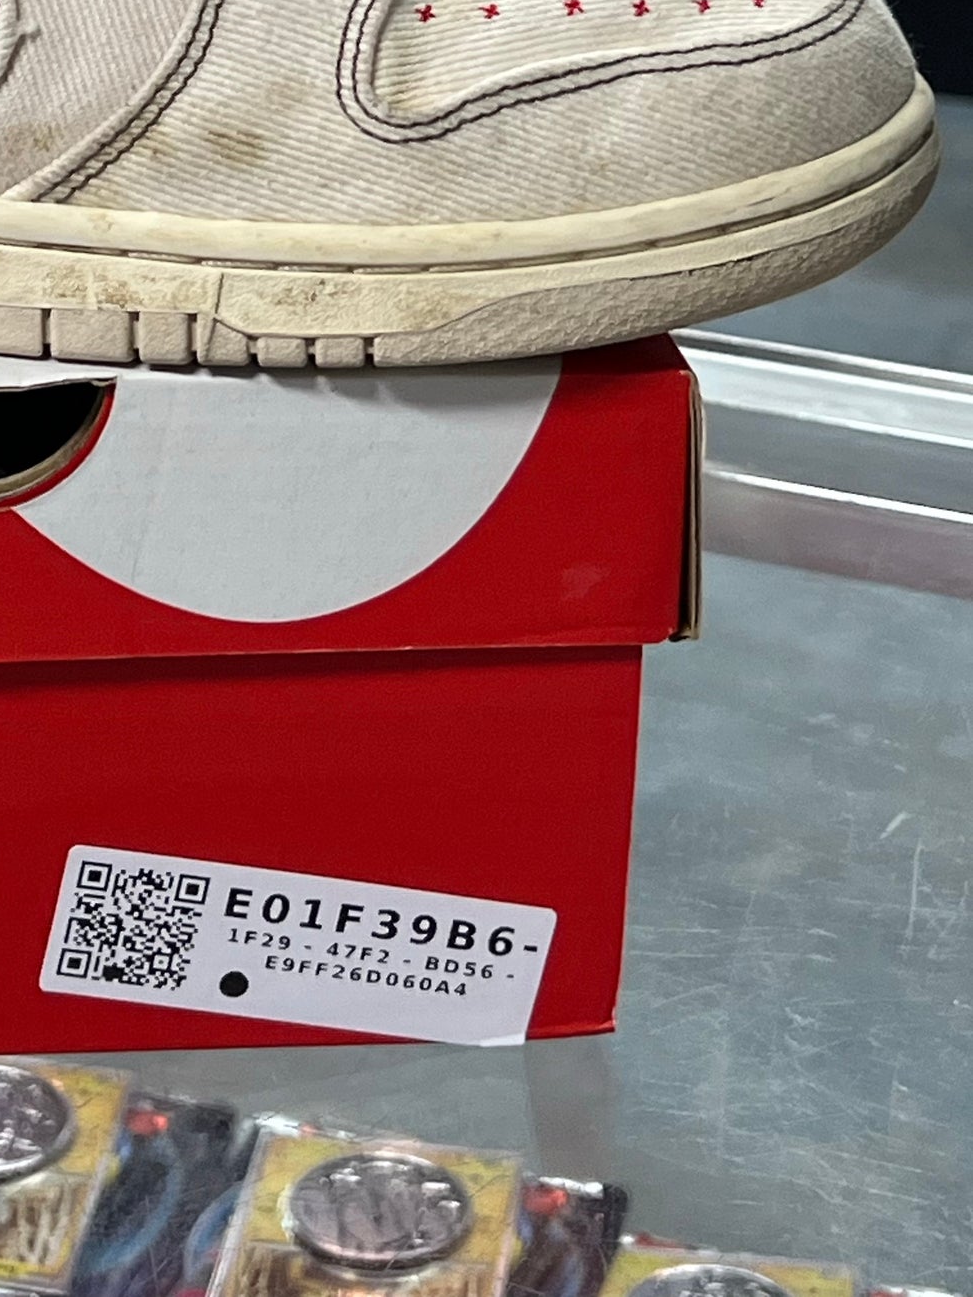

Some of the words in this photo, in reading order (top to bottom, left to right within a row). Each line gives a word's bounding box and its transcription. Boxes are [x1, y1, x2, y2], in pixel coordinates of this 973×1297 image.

[224, 887, 539, 957] E01F39B6-
[227, 928, 292, 950] 1F29
[326, 942, 390, 965] 47F2
[425, 956, 494, 980] BD56
[264, 955, 468, 996] E9FF26D060A4
